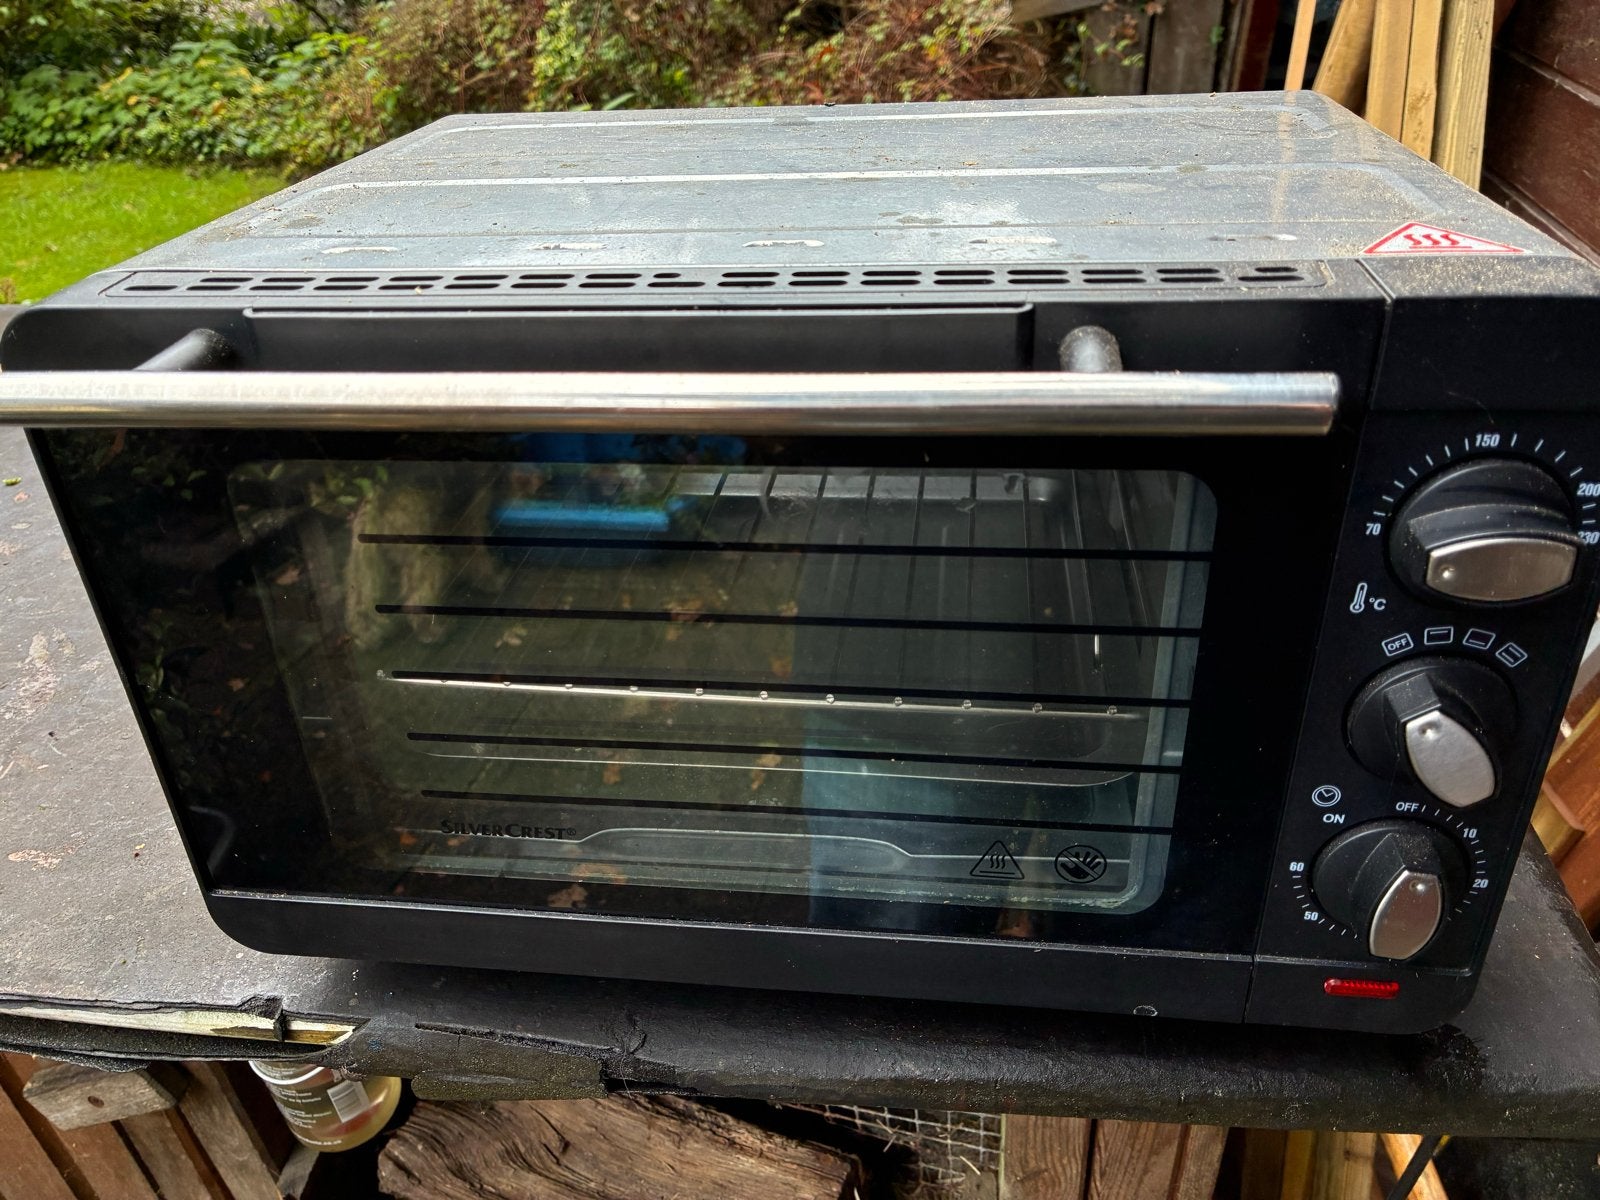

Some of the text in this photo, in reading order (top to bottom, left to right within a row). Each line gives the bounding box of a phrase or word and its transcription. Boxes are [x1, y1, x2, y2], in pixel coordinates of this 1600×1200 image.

[1475, 434, 1500, 447] 150
[1577, 483, 1600, 496] 200
[1366, 523, 1381, 535] 70
[1388, 637, 1408, 651] OFF
[1396, 802, 1419, 812] OFF
[1323, 814, 1345, 824] ON
[1463, 828, 1477, 838] 10
[1289, 862, 1304, 872] 60
[1473, 878, 1489, 889] 20
[1304, 911, 1319, 921] 50
